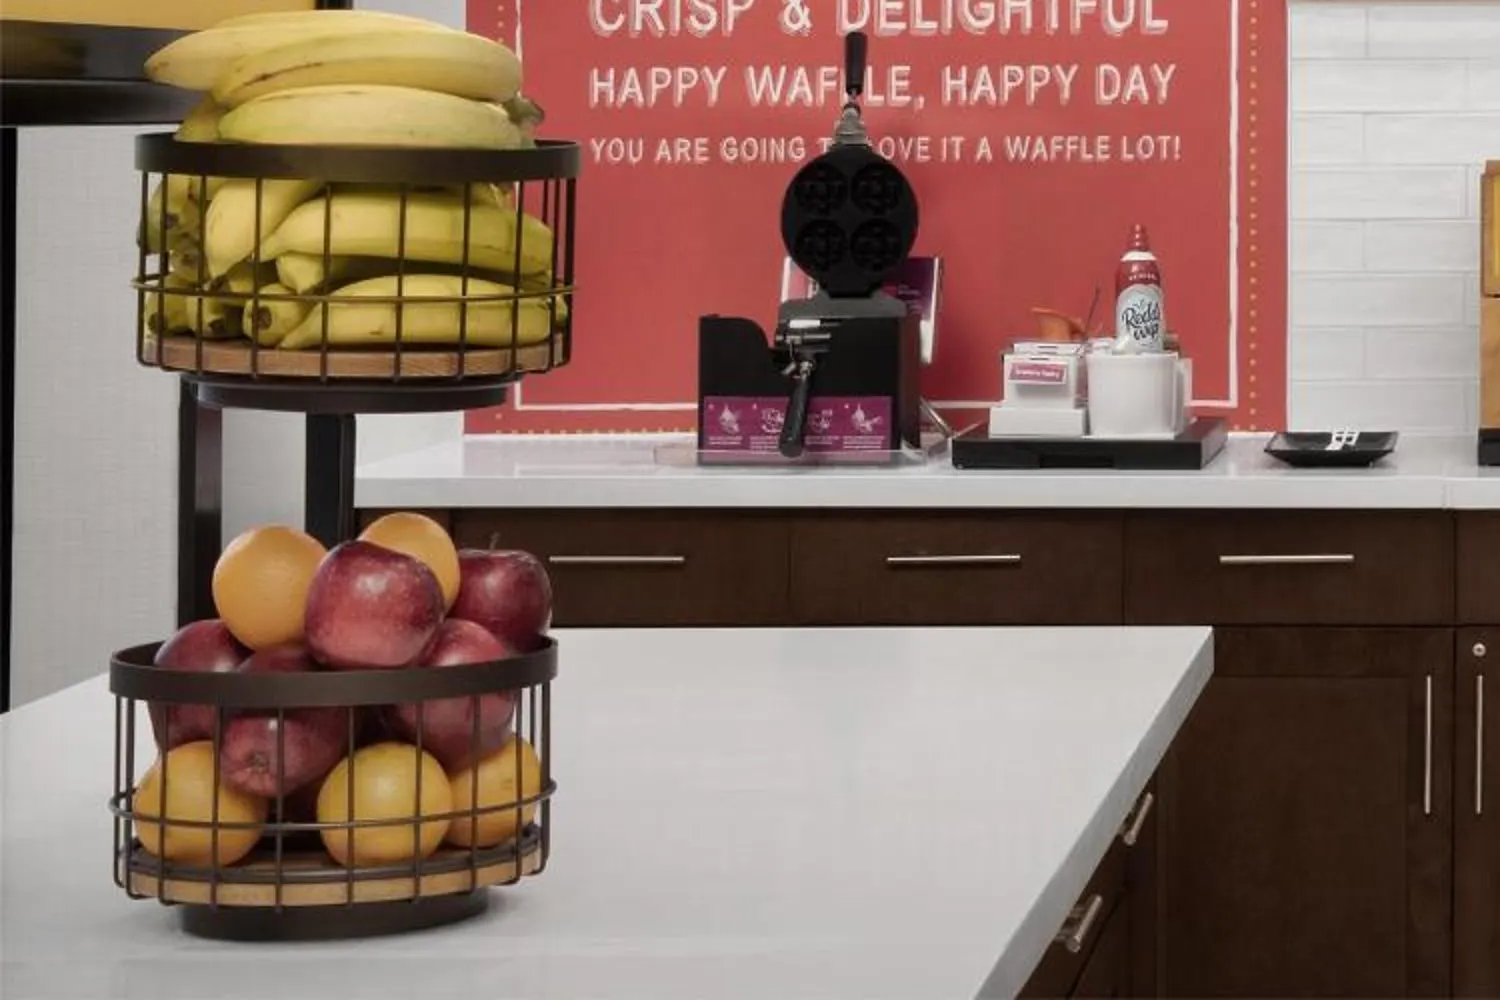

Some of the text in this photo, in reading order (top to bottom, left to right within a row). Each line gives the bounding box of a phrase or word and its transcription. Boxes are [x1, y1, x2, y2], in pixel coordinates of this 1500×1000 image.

[589, 63, 1176, 110] HAPPY WAFLE, HAPPY DAY
[591, 138, 643, 163] YOU
[654, 138, 710, 162] ARE
[720, 137, 806, 162] GOING
[866, 136, 931, 162] OVE
[940, 136, 965, 161] IT
[975, 136, 993, 161] A
[1005, 135, 1110, 161] WAFFLE
[1120, 134, 1182, 160] LOT!
